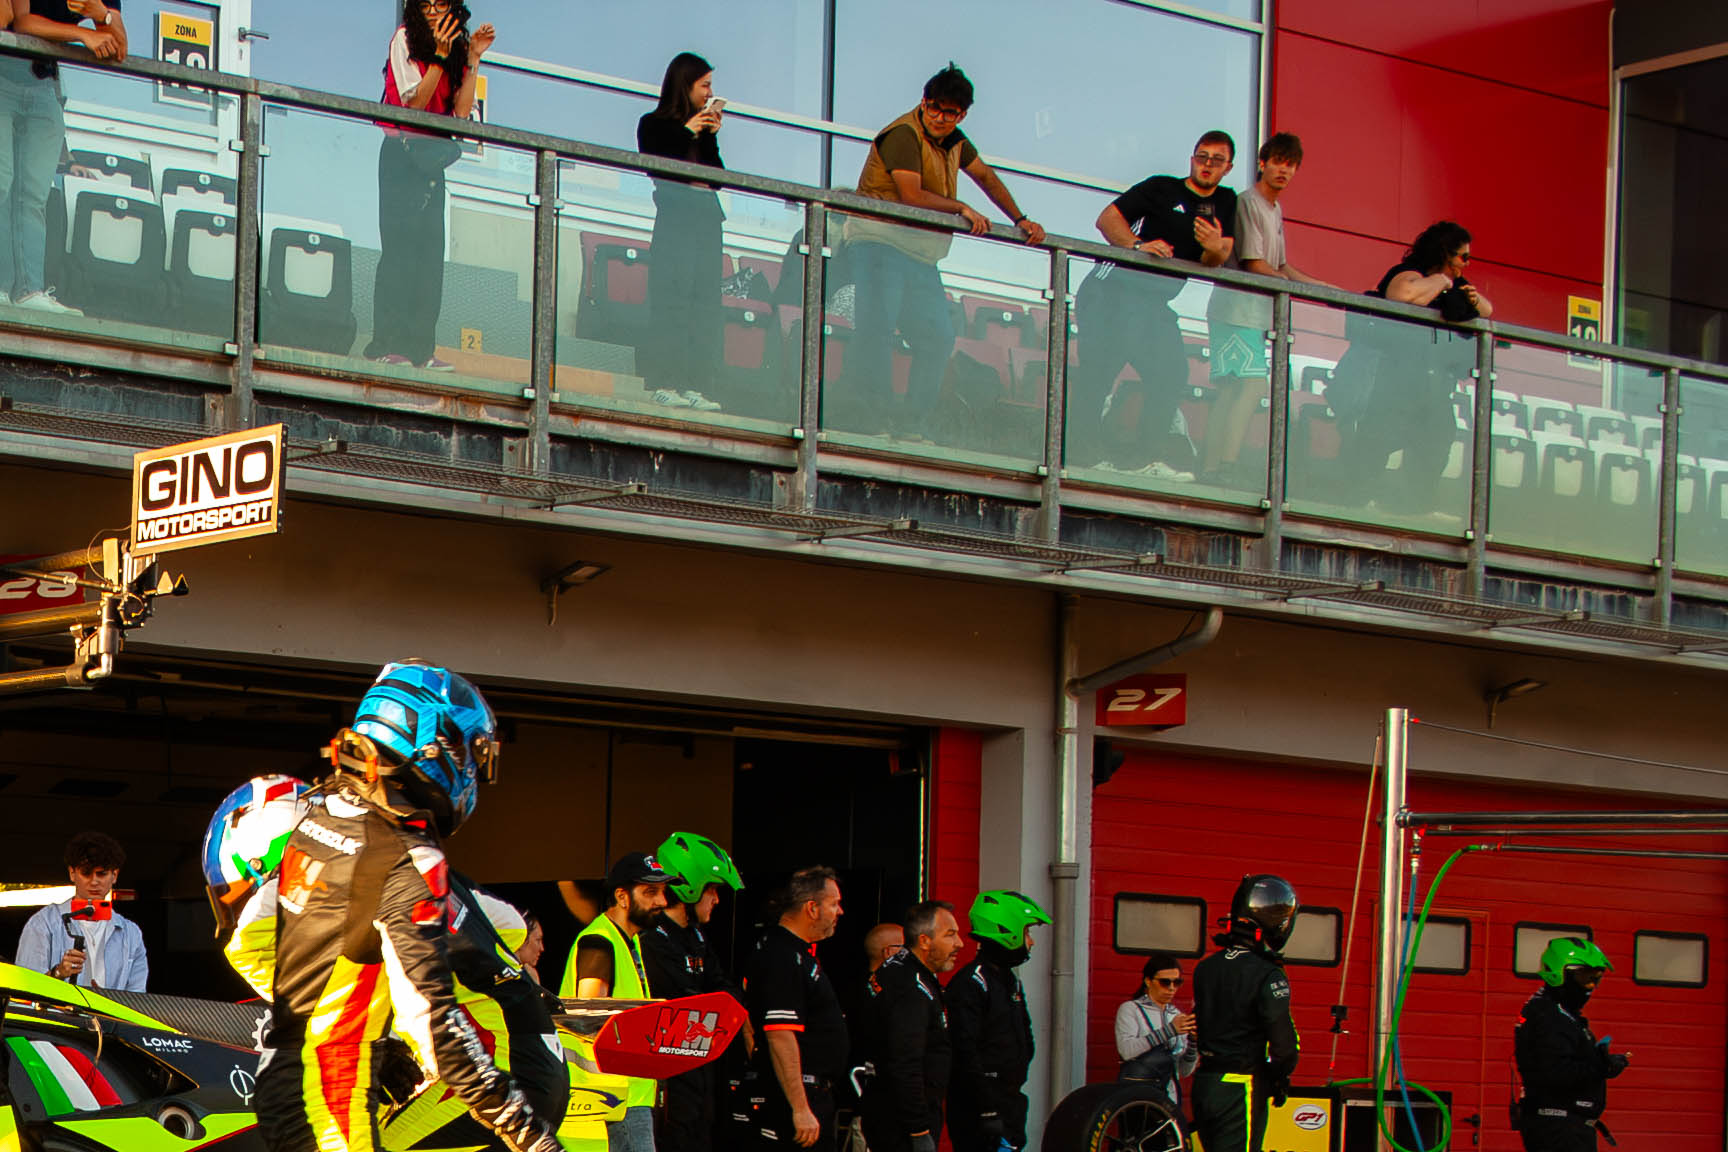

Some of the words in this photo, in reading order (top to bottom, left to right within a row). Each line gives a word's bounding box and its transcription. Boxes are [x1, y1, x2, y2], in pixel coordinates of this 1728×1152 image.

[175, 24, 197, 38] ZONA
[141, 440, 274, 512] GINO
[137, 500, 273, 542] MOTORSPORT
[1106, 687, 1183, 712] 27
[142, 1036, 194, 1049] LOMAC
[658, 1046, 709, 1058] MOTORSPORT
